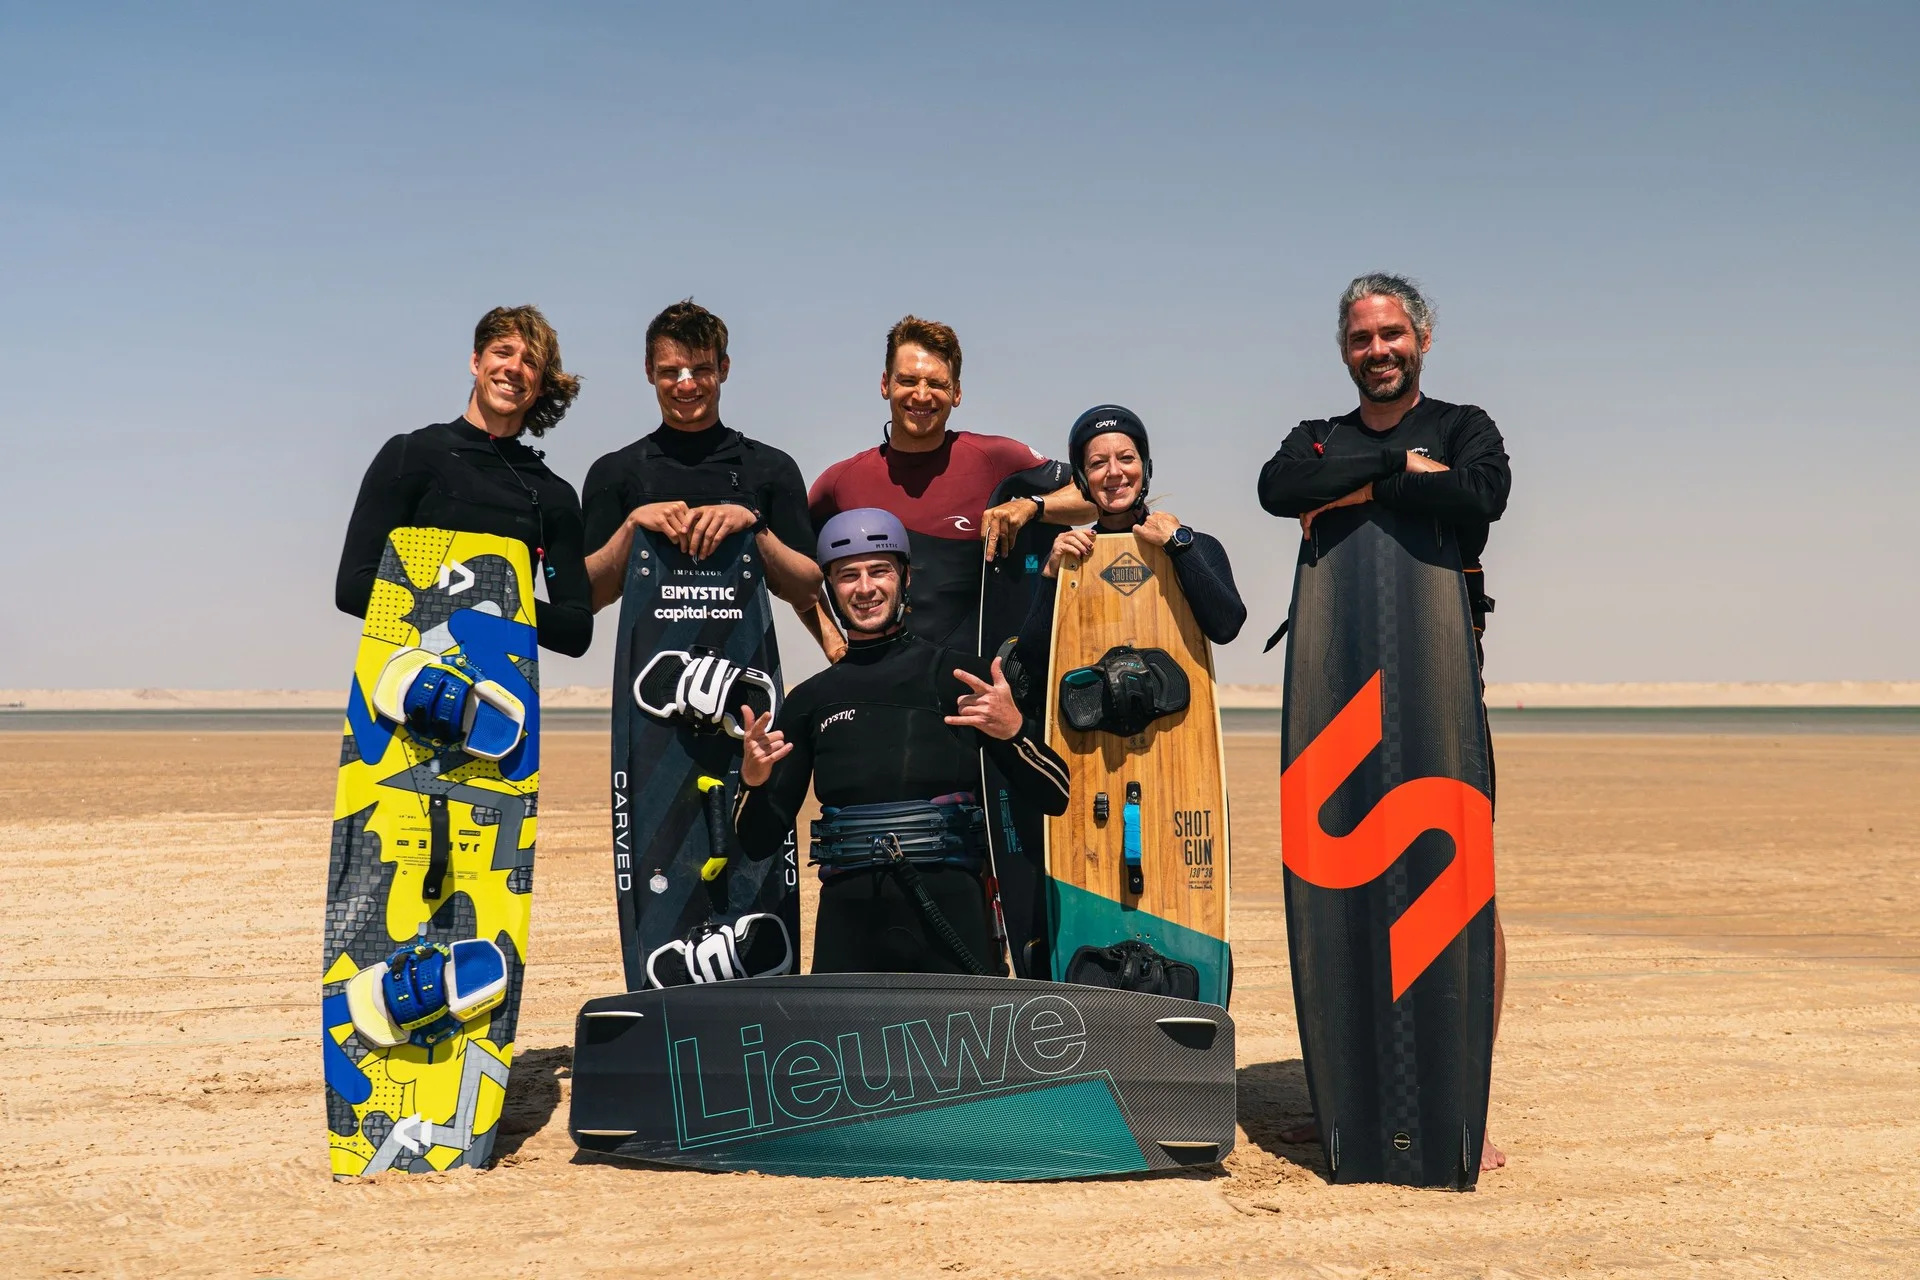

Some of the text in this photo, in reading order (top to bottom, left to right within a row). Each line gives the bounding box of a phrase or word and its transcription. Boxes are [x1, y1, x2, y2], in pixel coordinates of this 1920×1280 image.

[673, 569, 722, 577] IMPERATOR
[1110, 567, 1143, 582] SHOTGUN
[675, 585, 735, 601] MYSTIC
[820, 708, 856, 733] MYSTIC
[614, 770, 632, 892] CARVED
[1174, 810, 1211, 837] SHOT
[1184, 838, 1213, 866] GUN
[674, 994, 1087, 1142] Lieuwe
